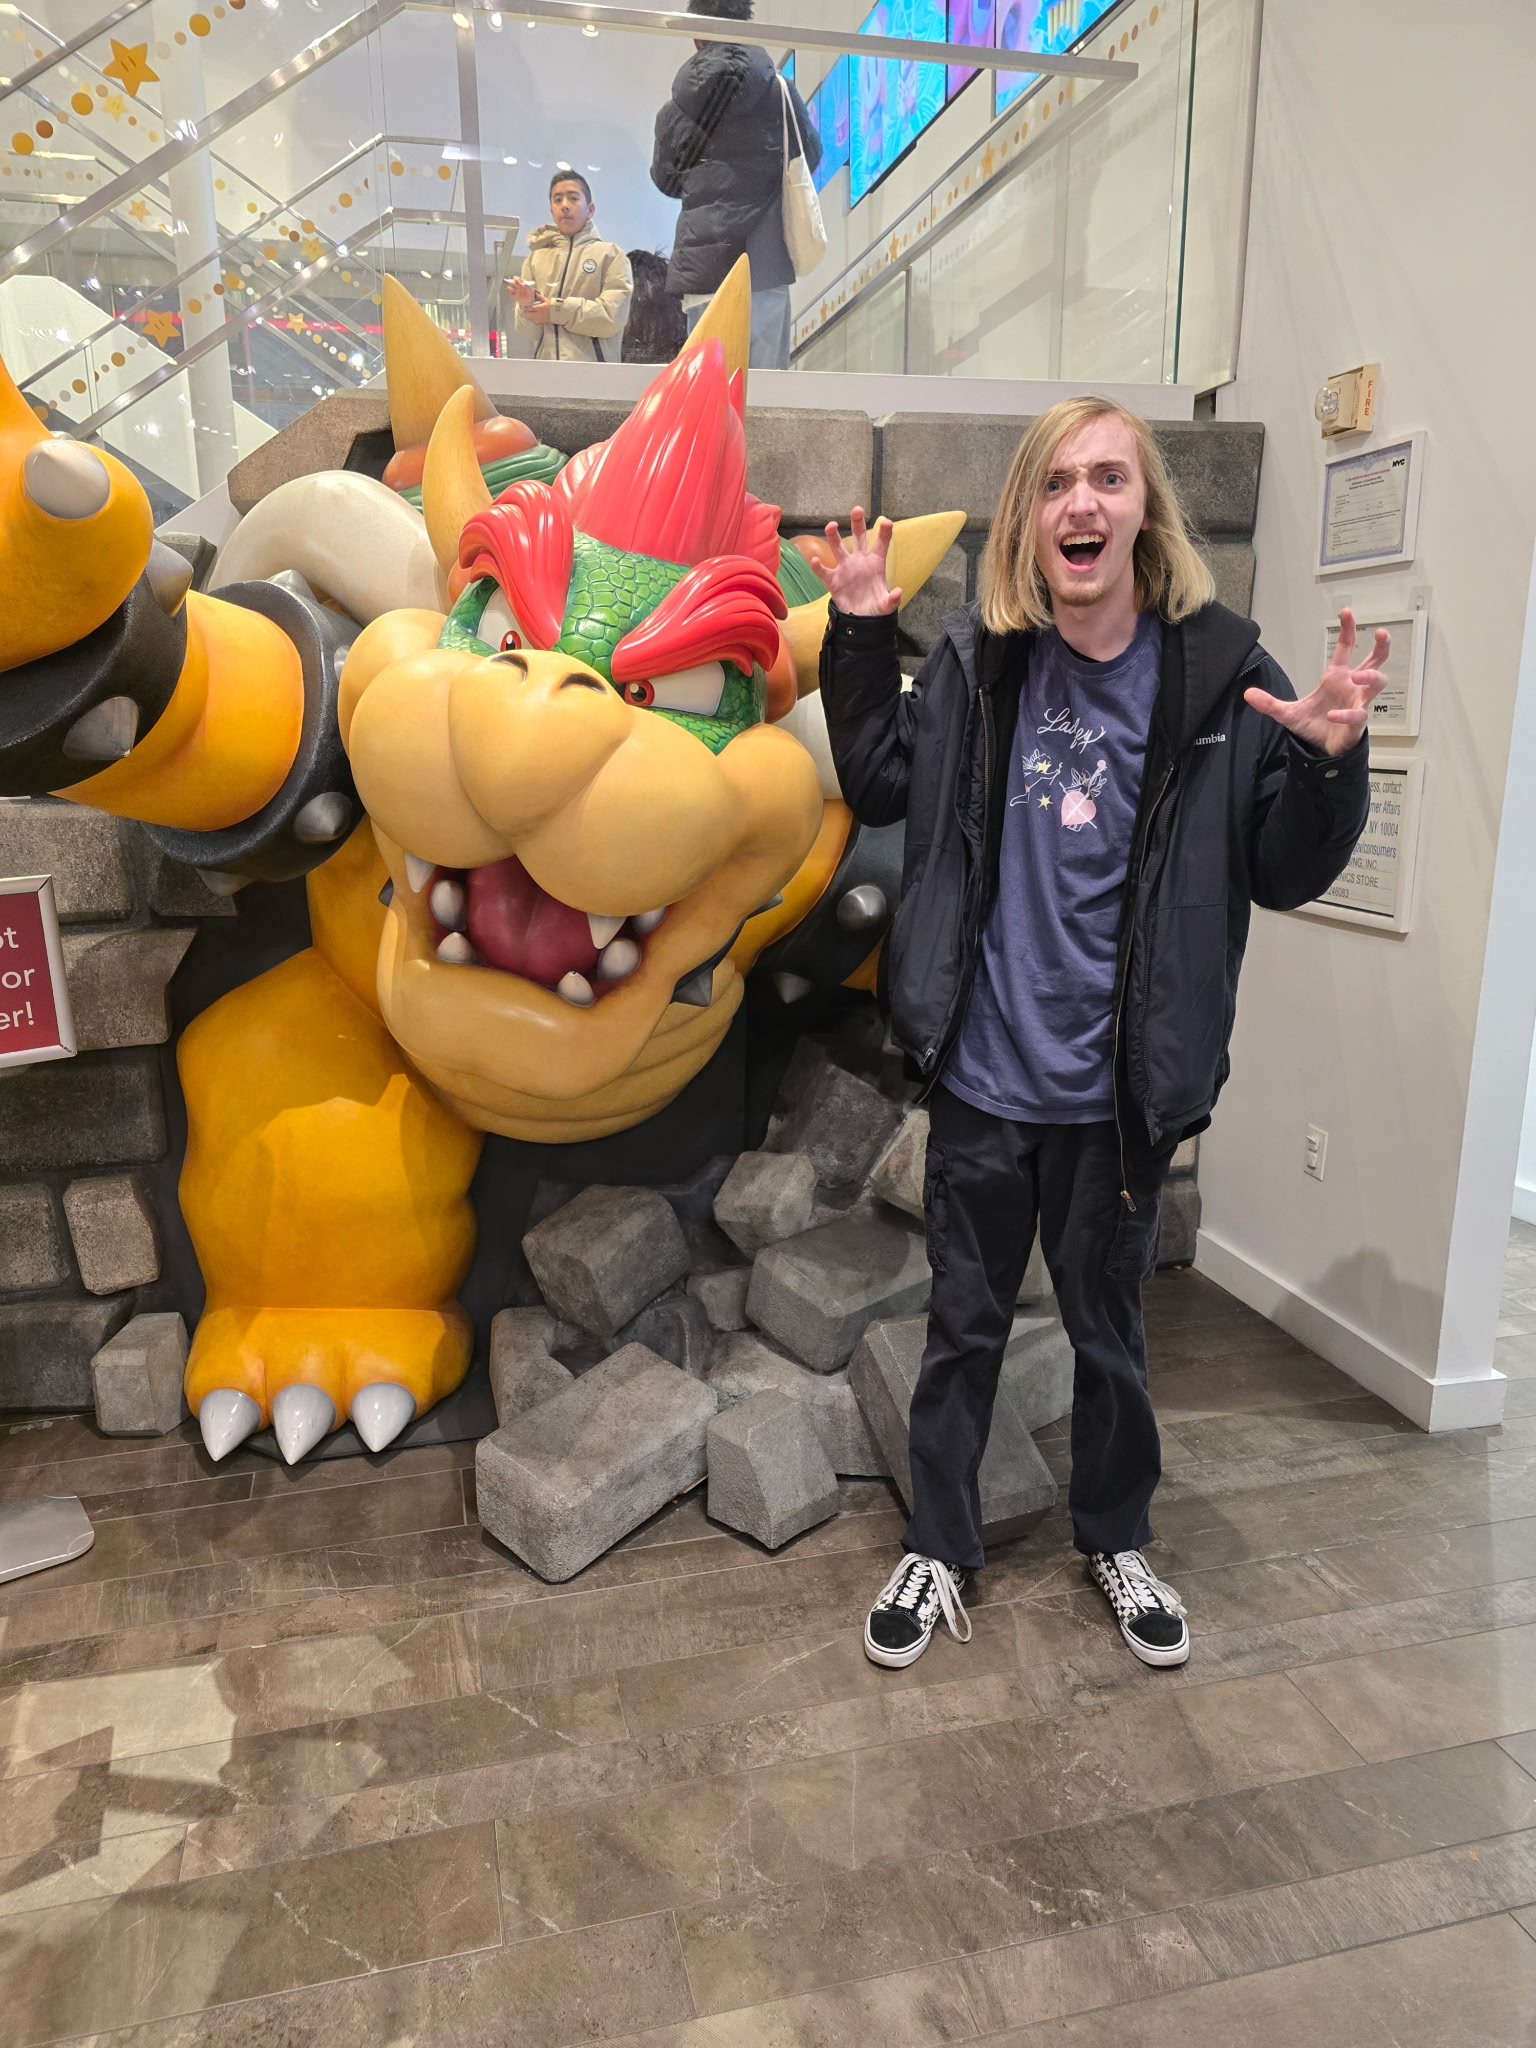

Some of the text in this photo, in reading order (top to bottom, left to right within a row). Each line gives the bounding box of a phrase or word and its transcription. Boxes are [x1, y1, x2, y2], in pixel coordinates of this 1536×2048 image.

[1364, 380, 1373, 416] FIRE
[1391, 459, 1405, 468] NYC
[1373, 704, 1388, 713] NYC
[1382, 800, 1401, 816] Affairs
[1369, 820, 1399, 837] NY 10004
[1356, 874, 1379, 888] STORE
[1326, 886, 1350, 899] 246083
[1, 968, 35, 989] or
